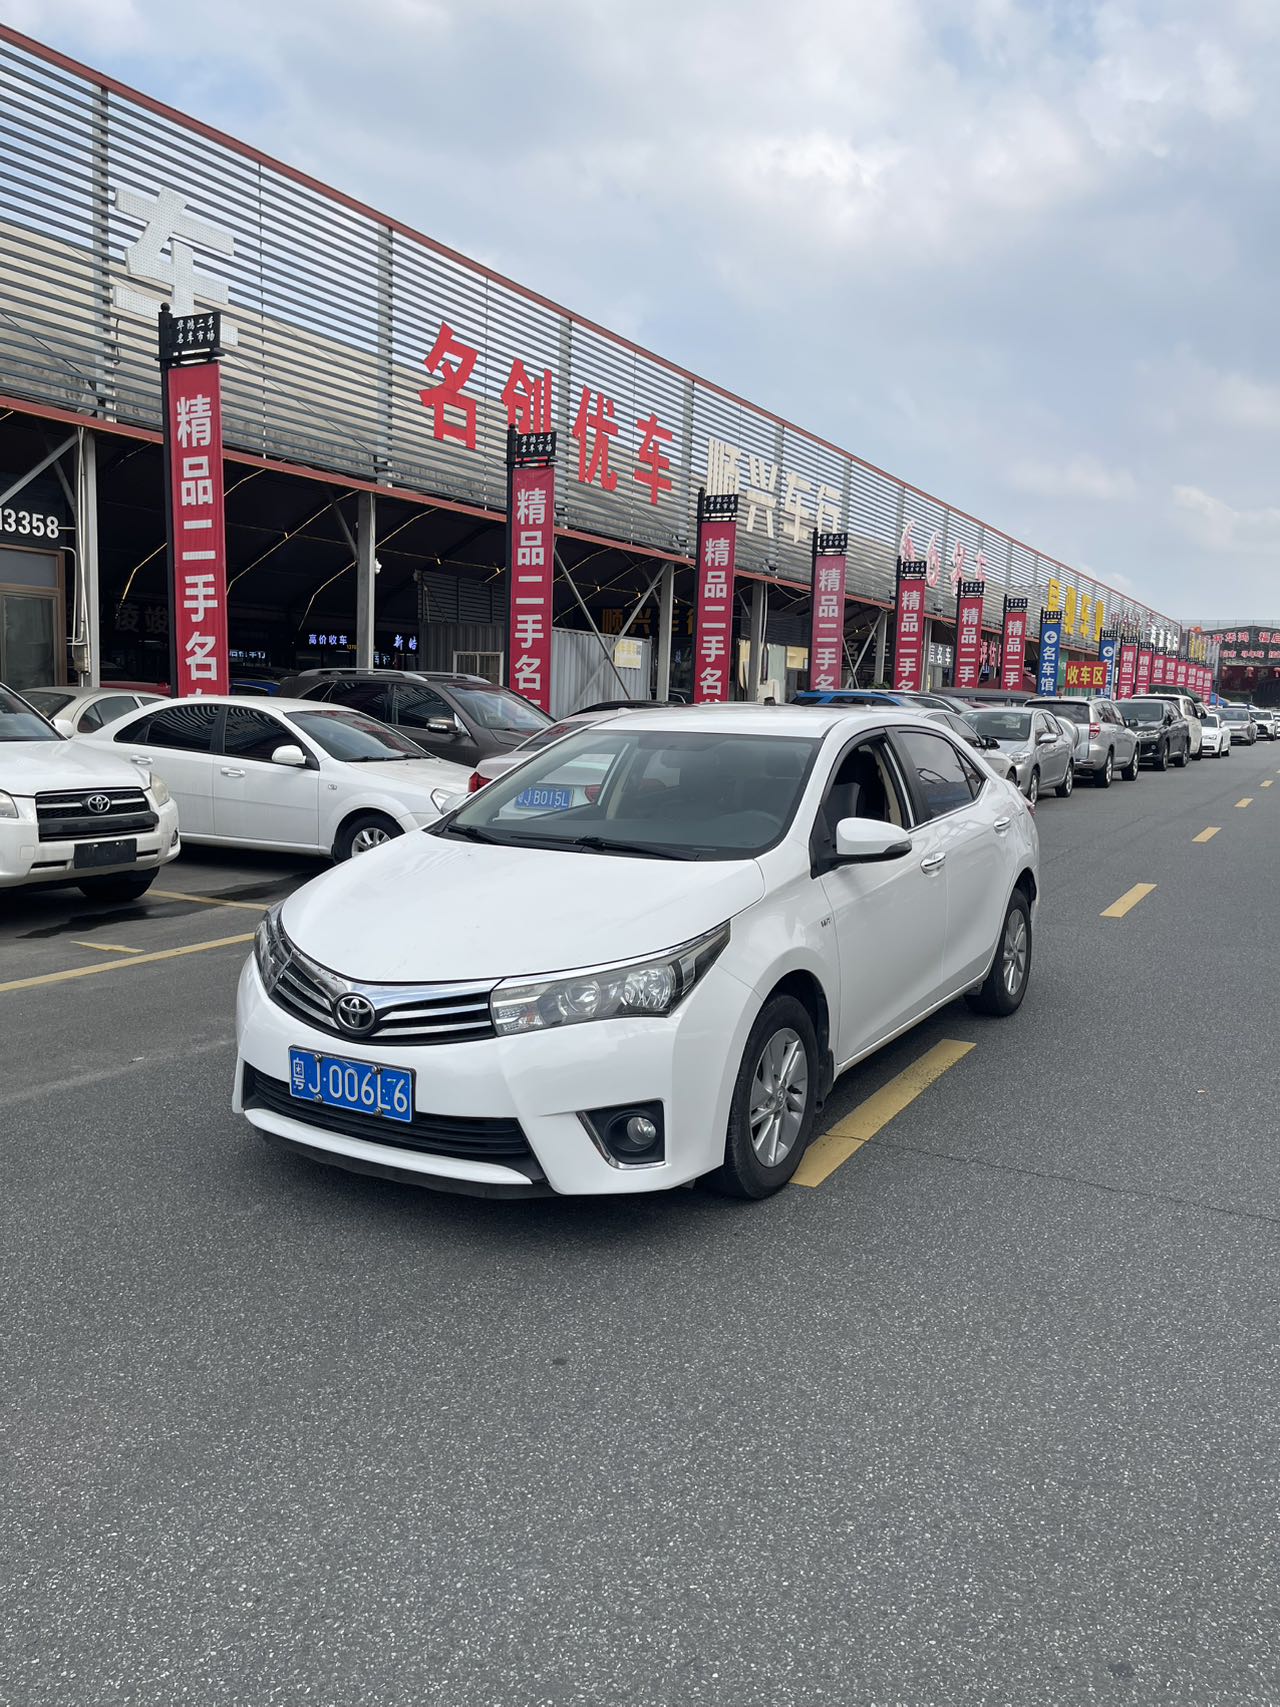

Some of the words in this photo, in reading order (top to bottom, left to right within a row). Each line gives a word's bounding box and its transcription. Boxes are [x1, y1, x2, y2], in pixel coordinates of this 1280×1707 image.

[176, 315, 215, 331] 华鸿二手
[176, 330, 215, 344] 名车市场
[418, 321, 673, 505] 名创优车
[706, 437, 843, 544] 顺兴车行
[176, 394, 219, 697] 精品二手名
[515, 488, 546, 706] 精品二手名
[700, 538, 730, 703] 精品二手名
[309, 634, 348, 645] 高价收车
[958, 608, 979, 688] 精品二手
[1067, 665, 1104, 685] 收车区
[518, 787, 569, 807] J·B015L
[292, 1057, 408, 1113] 粤J·006L6
